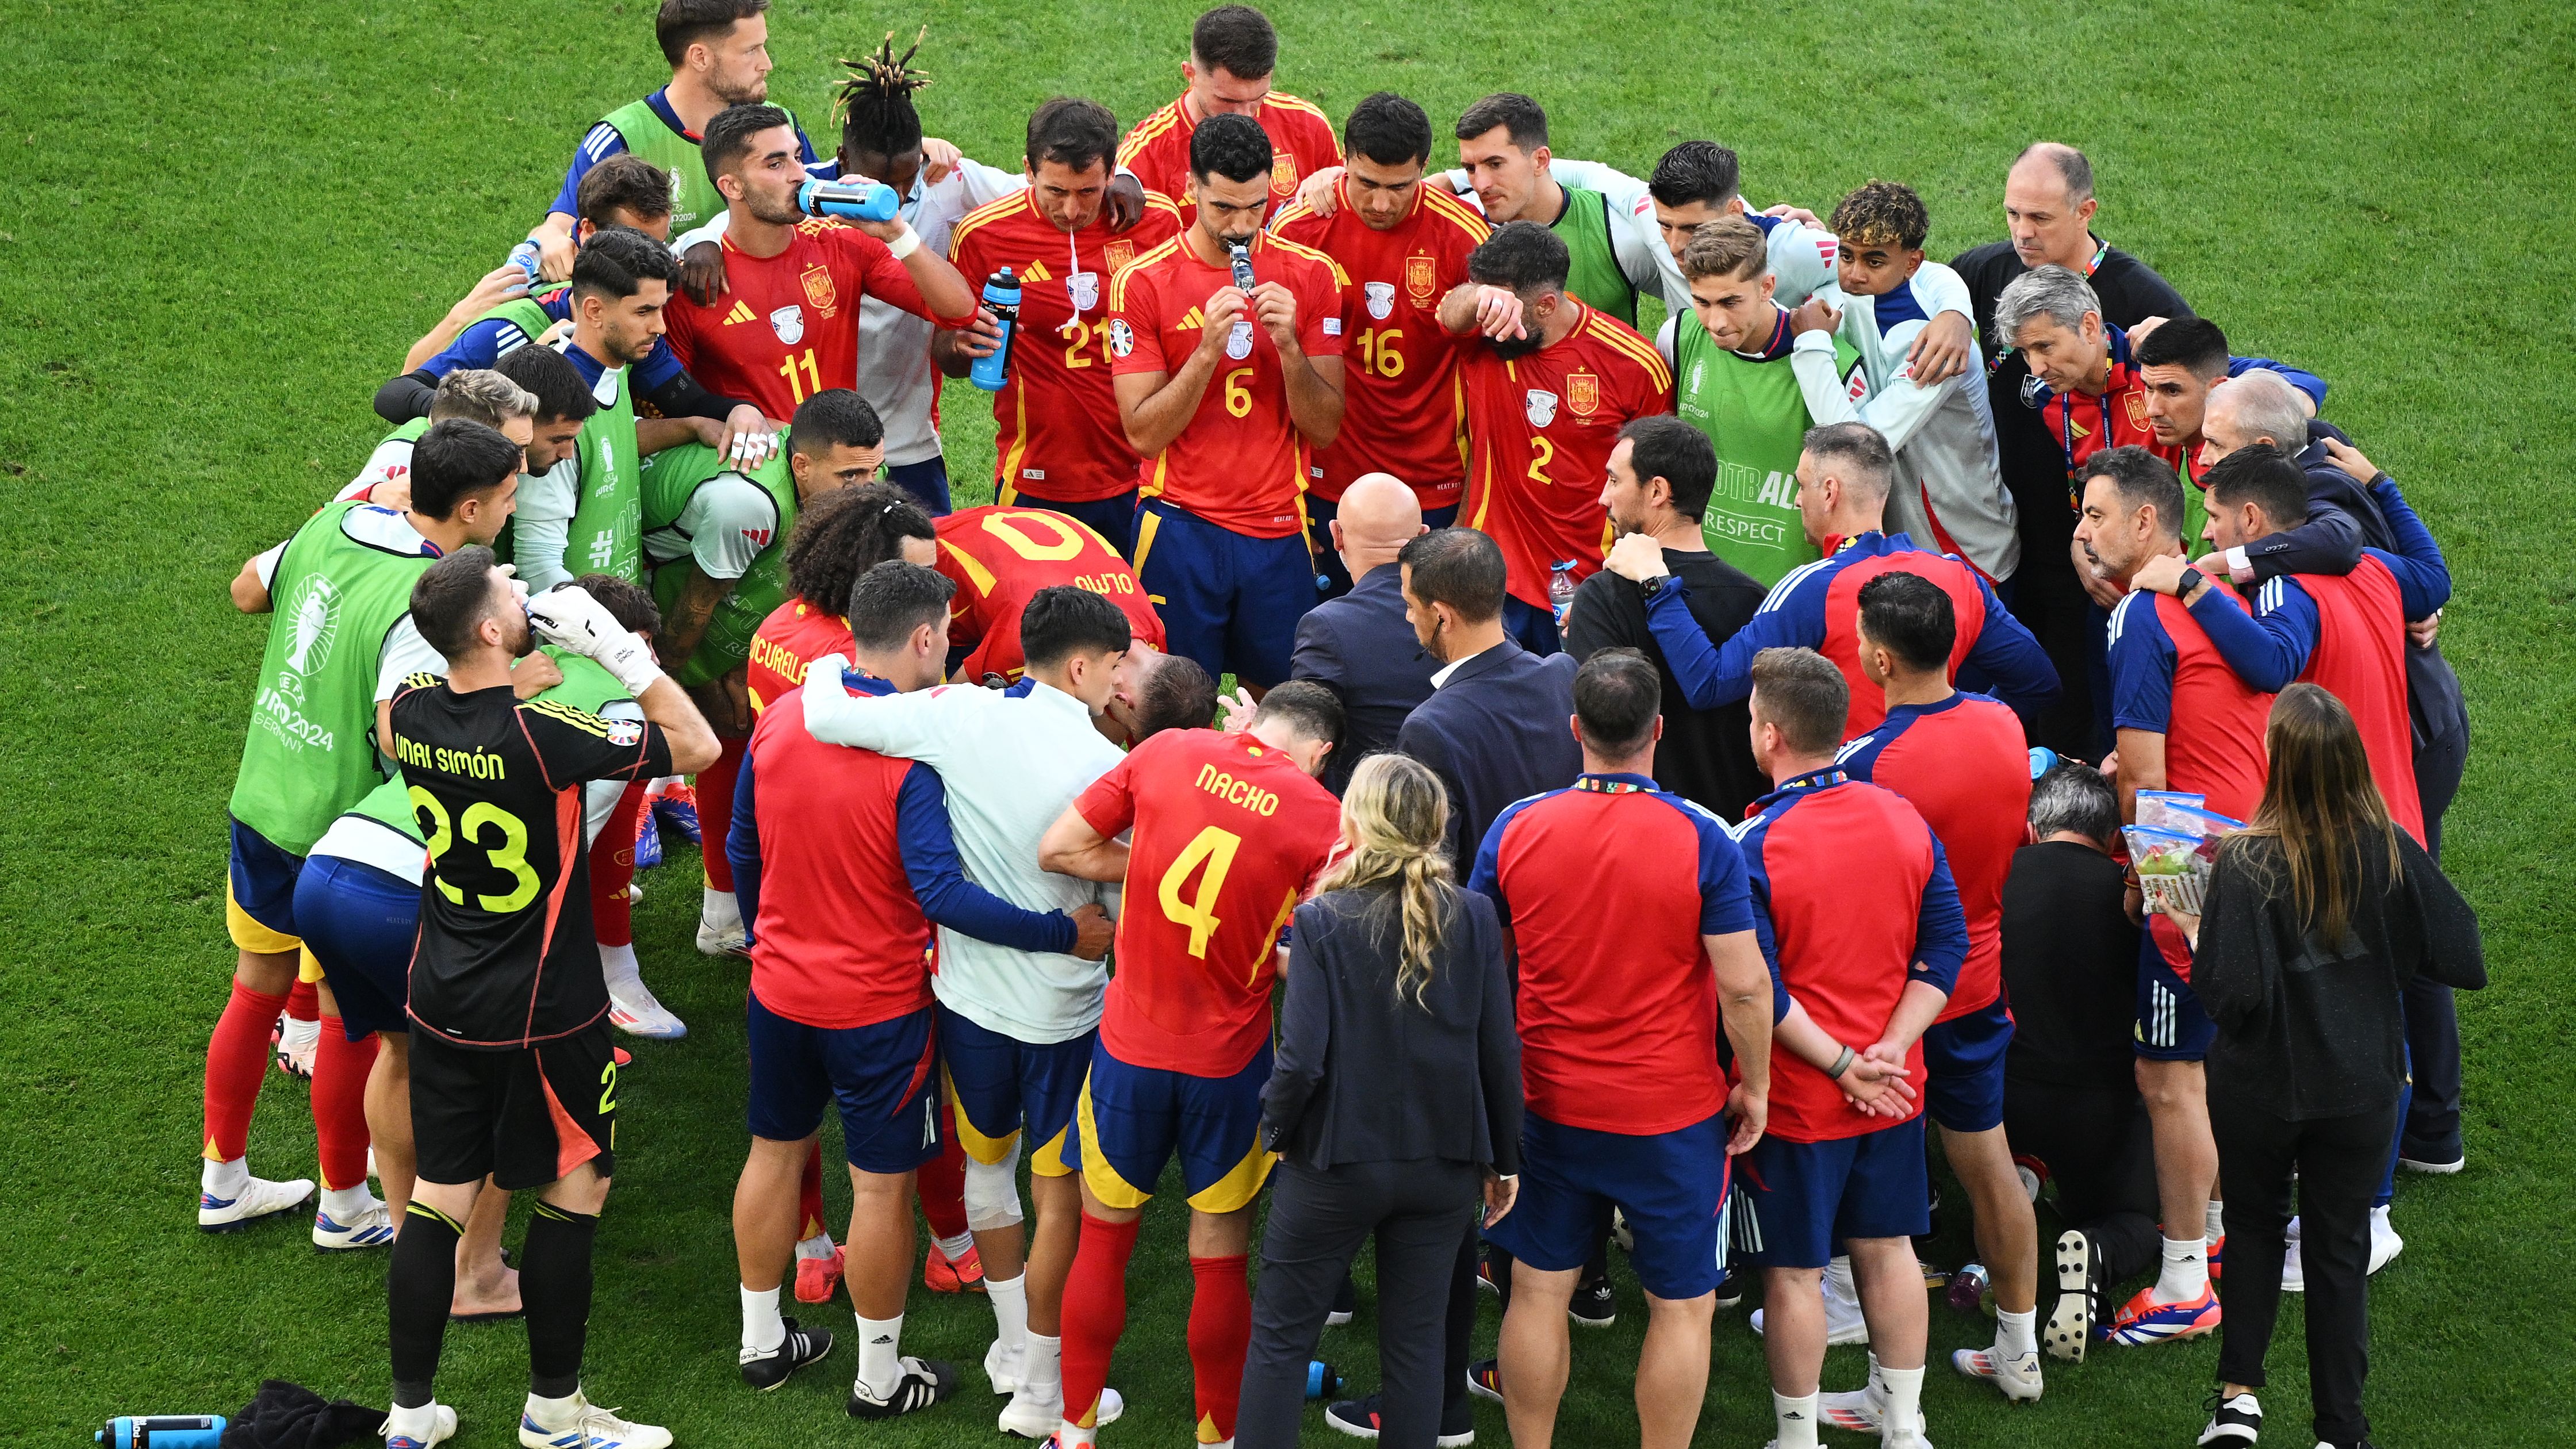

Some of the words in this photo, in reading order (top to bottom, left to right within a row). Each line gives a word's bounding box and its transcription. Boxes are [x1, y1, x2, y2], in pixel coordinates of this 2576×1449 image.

[1063, 317, 1111, 368] 21
[1358, 328, 1404, 377] 16
[780, 348, 821, 405] 11
[1225, 368, 1254, 418] 6
[1527, 436, 1553, 485] 2
[1704, 511, 1785, 542] RESPECT
[254, 712, 304, 753] GERMANY
[396, 733, 432, 769] UNAI
[435, 746, 505, 780] SIMÓN
[1195, 764, 1279, 816] NACHO
[408, 785, 541, 913] 23
[1158, 826, 1241, 960] 4
